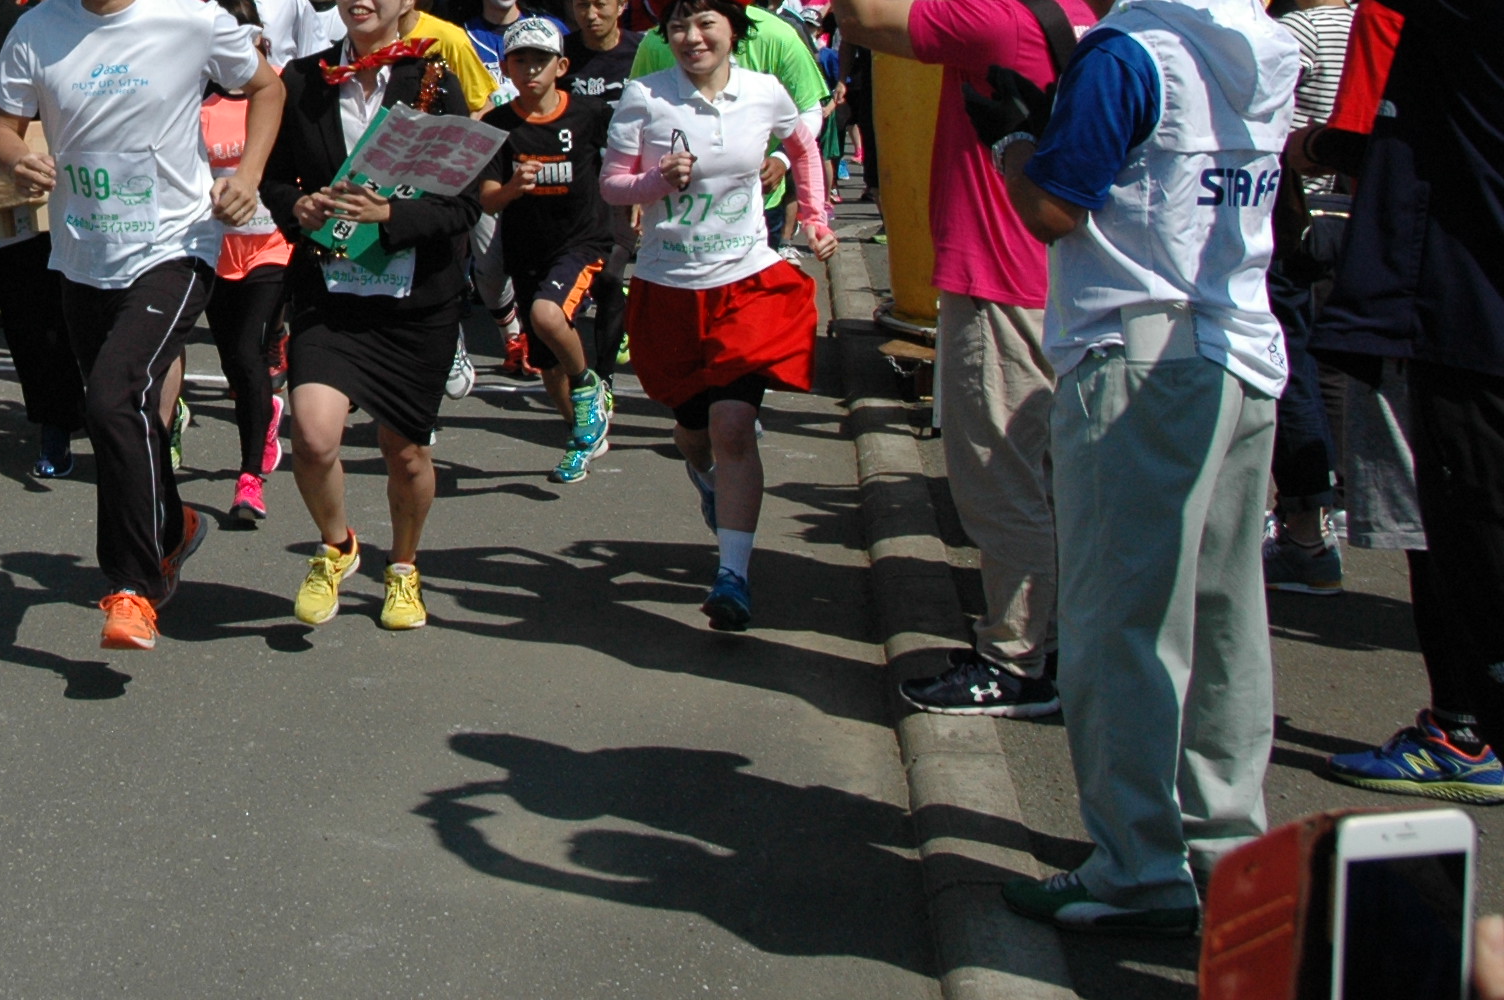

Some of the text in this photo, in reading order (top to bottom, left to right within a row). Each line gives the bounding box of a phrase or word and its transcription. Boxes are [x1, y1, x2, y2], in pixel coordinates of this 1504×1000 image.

[71, 79, 149, 91] PUT UP WITH
[558, 128, 573, 152] 9
[63, 163, 111, 201] 199
[512, 161, 573, 184] MA
[1197, 167, 1281, 207] STAFF
[661, 193, 713, 226] 127
